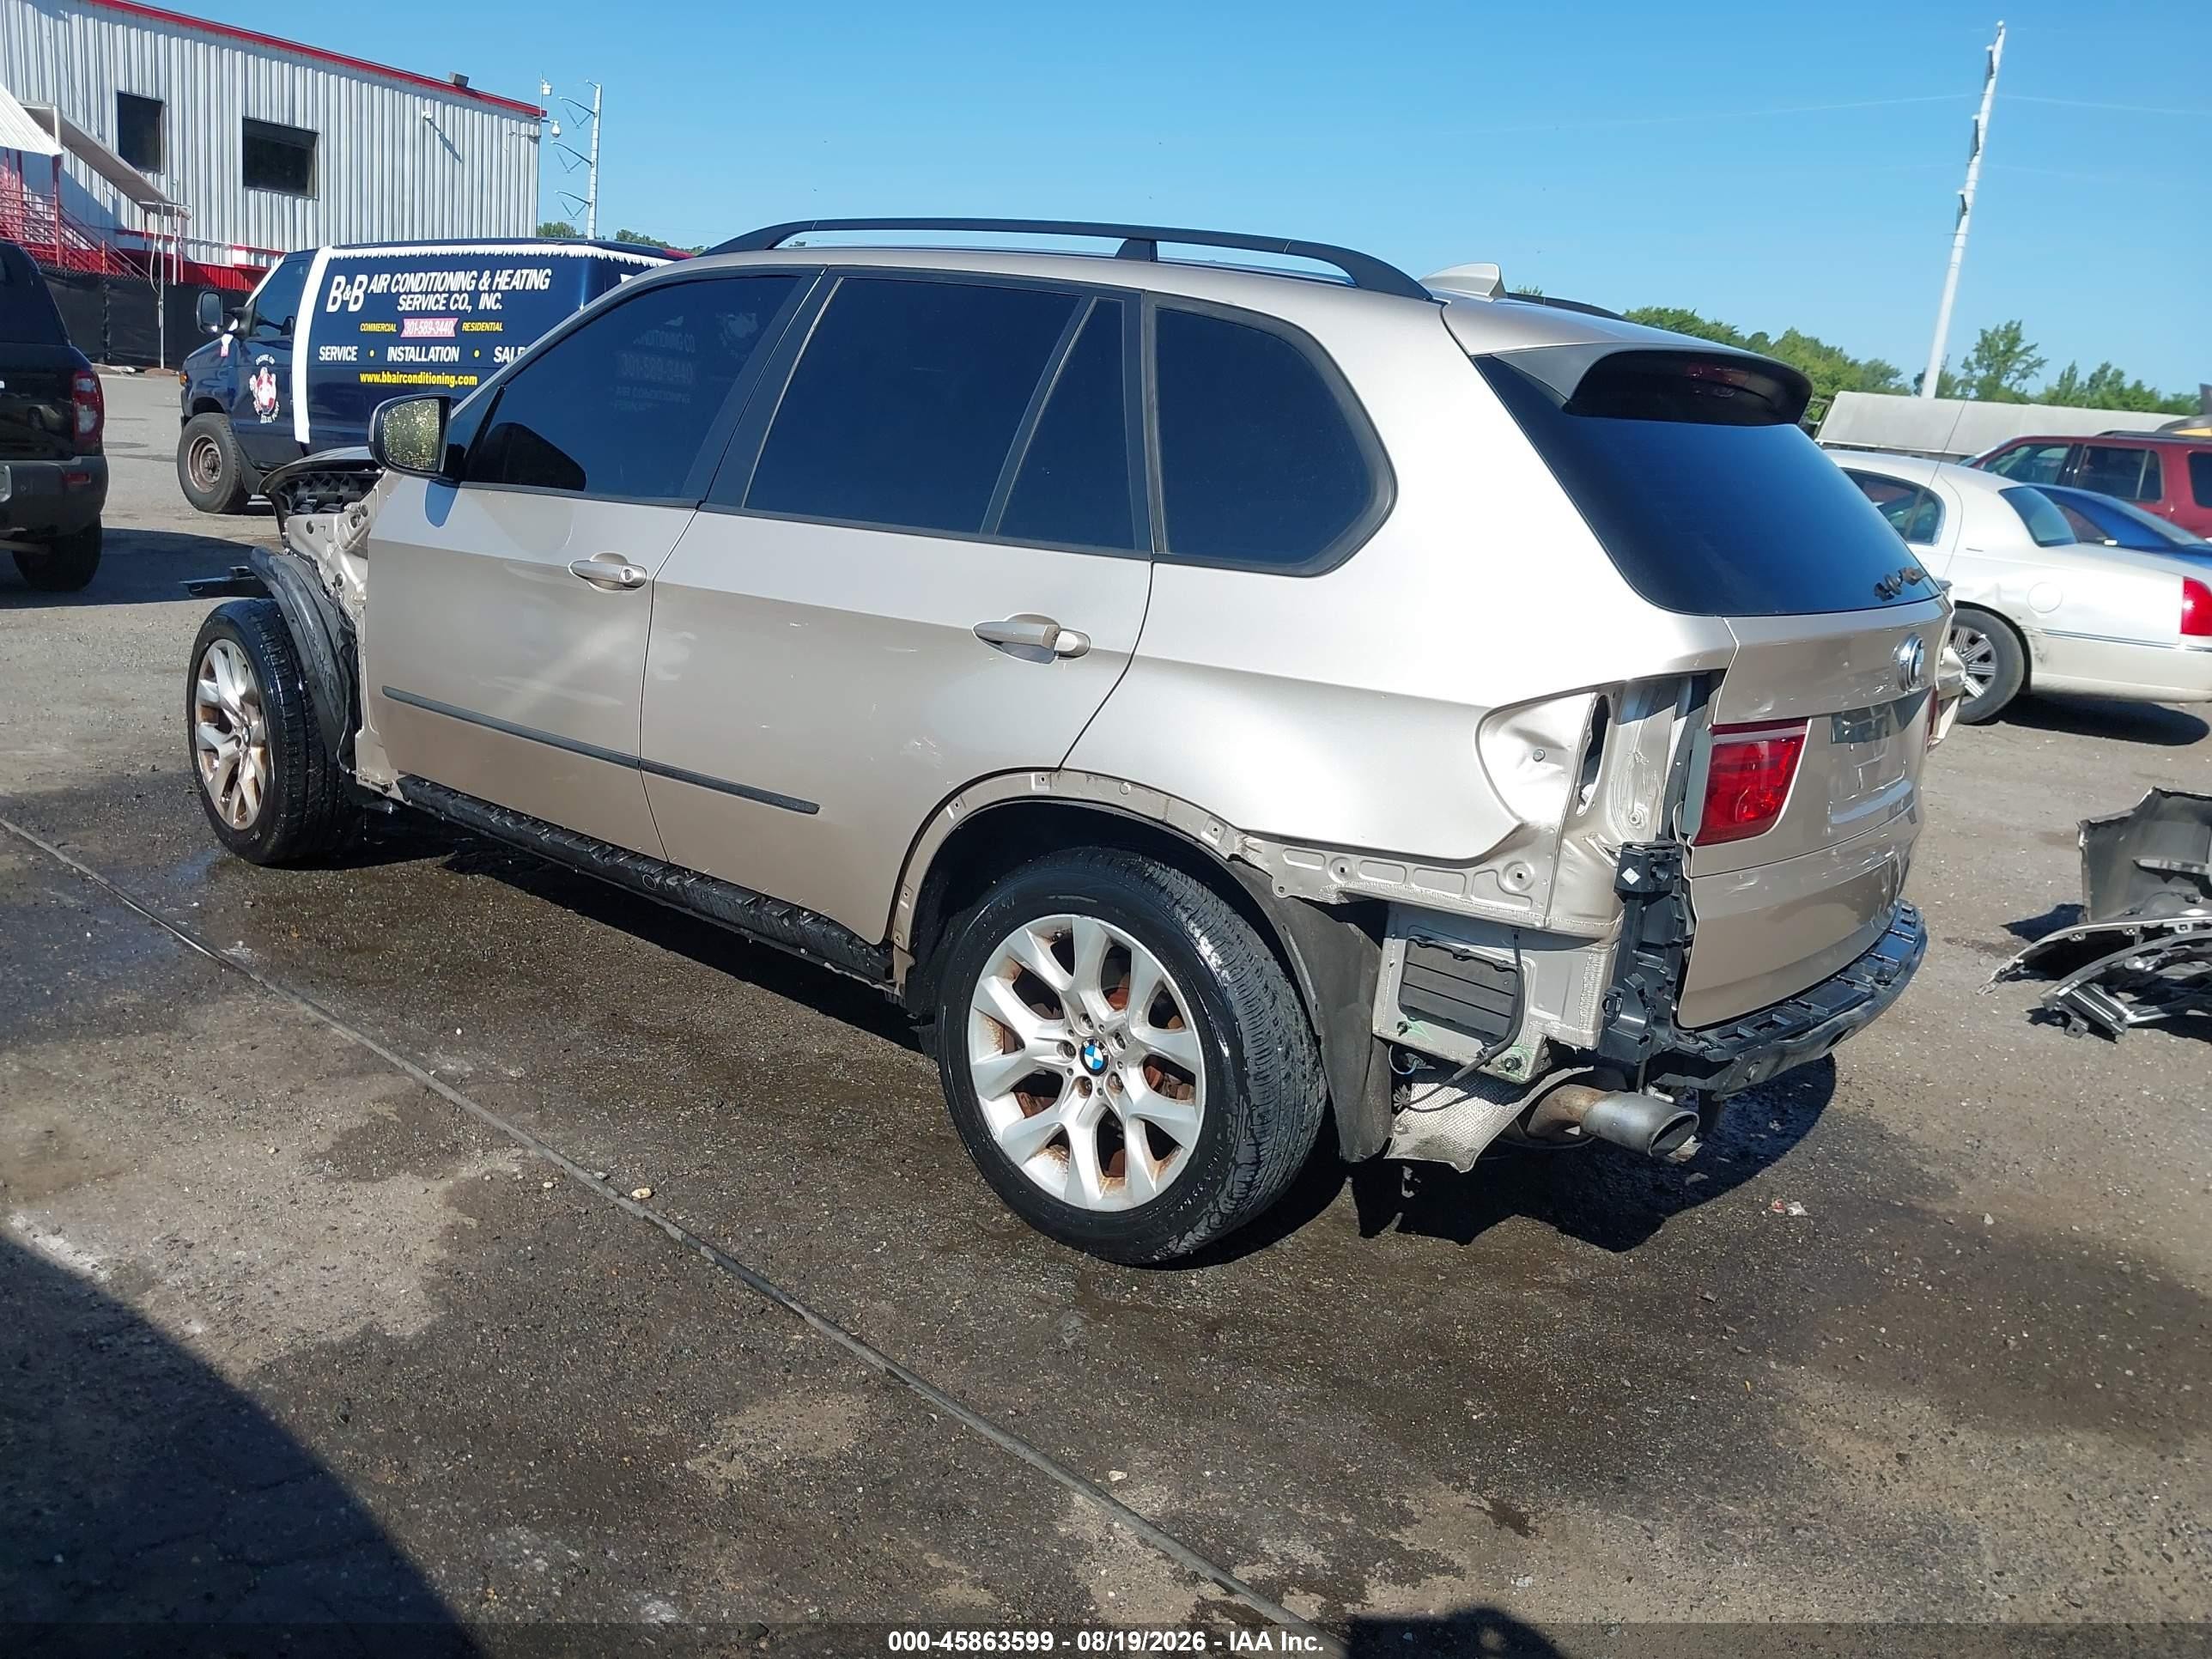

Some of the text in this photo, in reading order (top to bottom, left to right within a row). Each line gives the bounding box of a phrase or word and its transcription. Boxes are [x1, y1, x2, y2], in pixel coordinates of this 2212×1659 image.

[325, 268, 552, 313] B&B AIR CONDITIONING & HEATING
[397, 293, 449, 312] SERVICE
[477, 292, 503, 311] INC.
[360, 319, 504, 335] COMMERCIAL 301-589-3440 RESIDENTIAL
[319, 345, 358, 362] SERVICE
[386, 345, 460, 362] INSTALLATION
[359, 370, 477, 387] www.bbairconditioning.com
